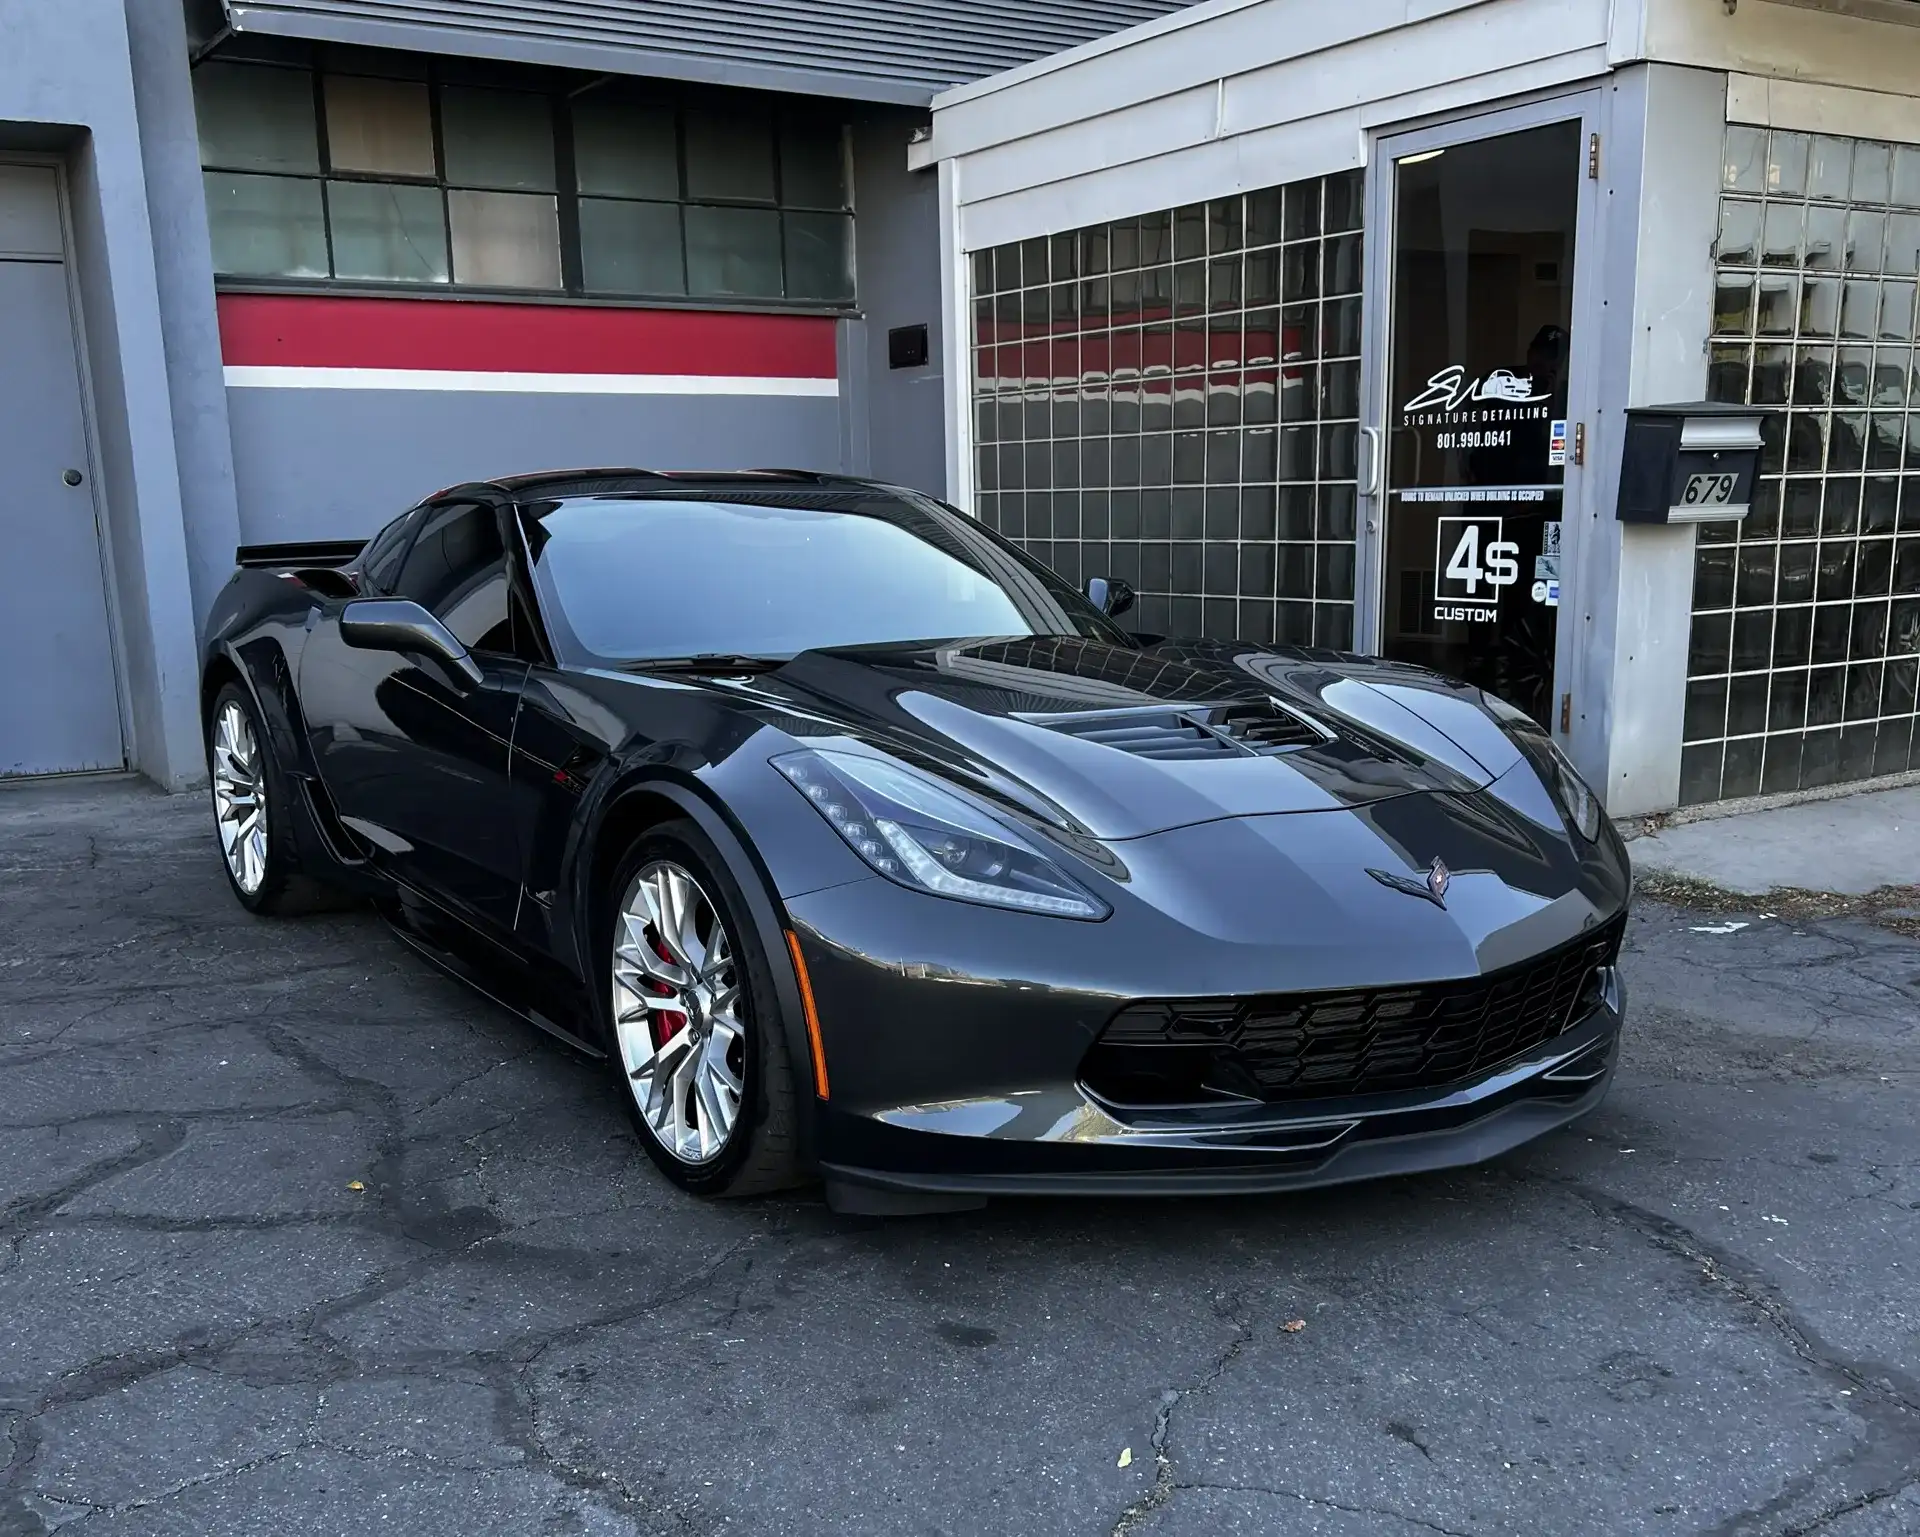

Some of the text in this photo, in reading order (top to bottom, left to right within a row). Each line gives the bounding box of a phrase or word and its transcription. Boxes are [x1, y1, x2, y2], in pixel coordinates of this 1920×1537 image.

[1403, 406, 1549, 427] SIGNATURE DETAILING
[1437, 430, 1511, 449] 801.990.0641
[1518, 491, 1544, 502] OCCUPIED
[1685, 475, 1733, 505] 679
[1434, 606, 1497, 623] CUSTOM
